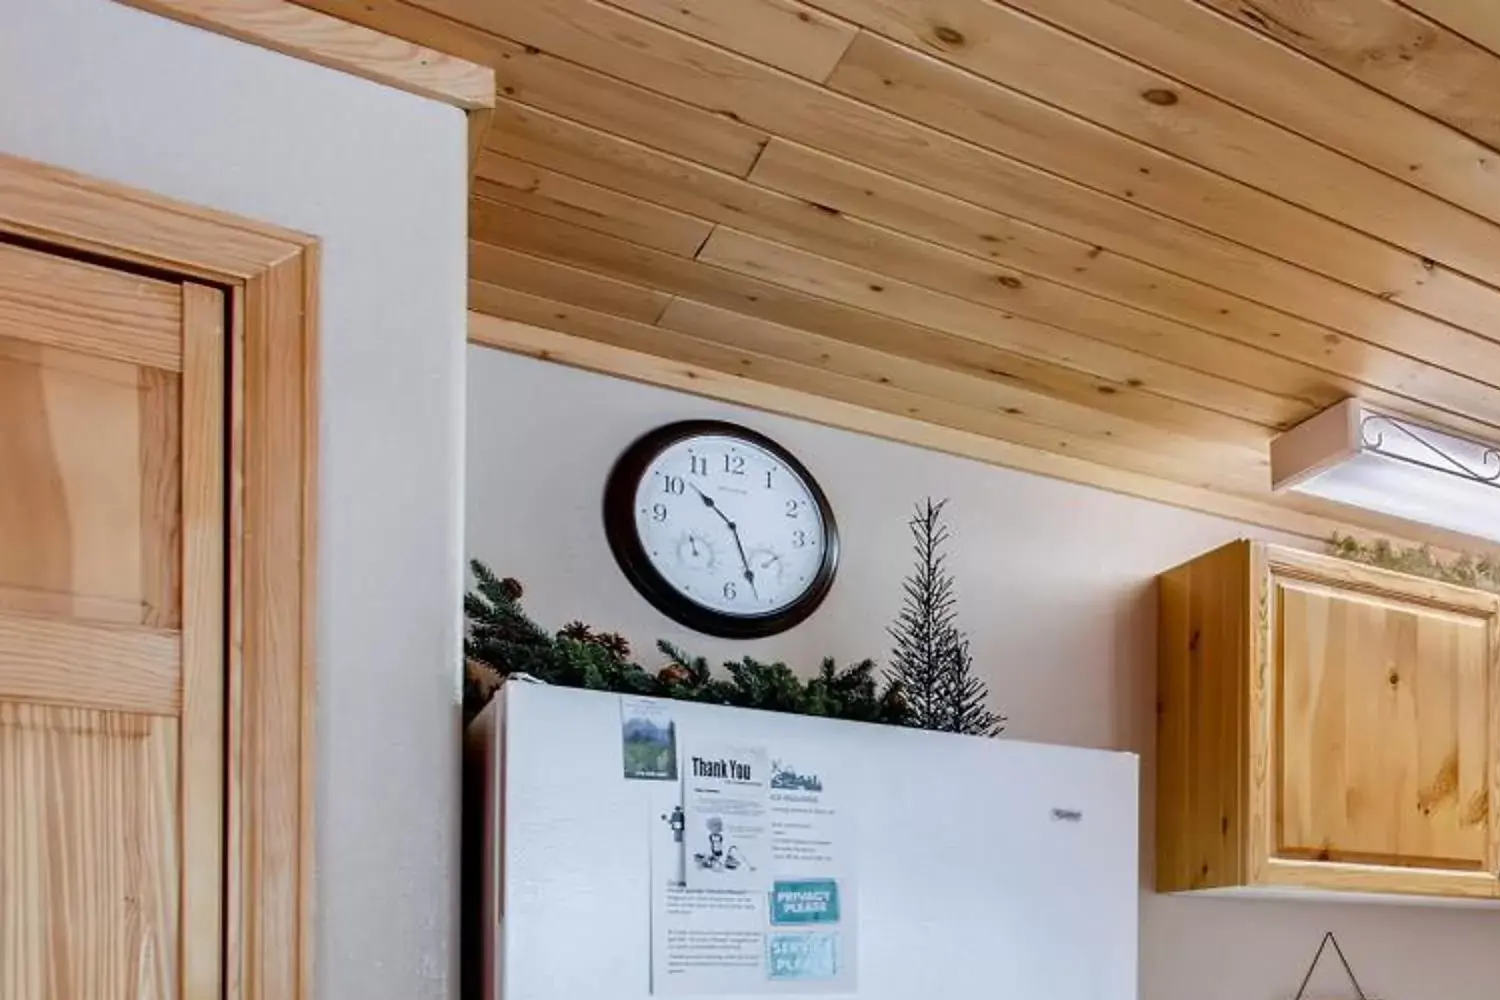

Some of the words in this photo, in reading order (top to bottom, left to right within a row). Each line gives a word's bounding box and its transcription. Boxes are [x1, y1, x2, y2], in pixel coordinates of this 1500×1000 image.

[690, 455, 708, 476] 11
[723, 454, 745, 476] 12
[663, 475, 685, 496] 10
[765, 471, 772, 489] 1
[653, 503, 667, 522] 9
[785, 500, 798, 519] 2
[793, 529, 805, 548] 3
[723, 582, 737, 601] 6
[692, 757, 727, 779] Thank
[729, 759, 751, 781] You
